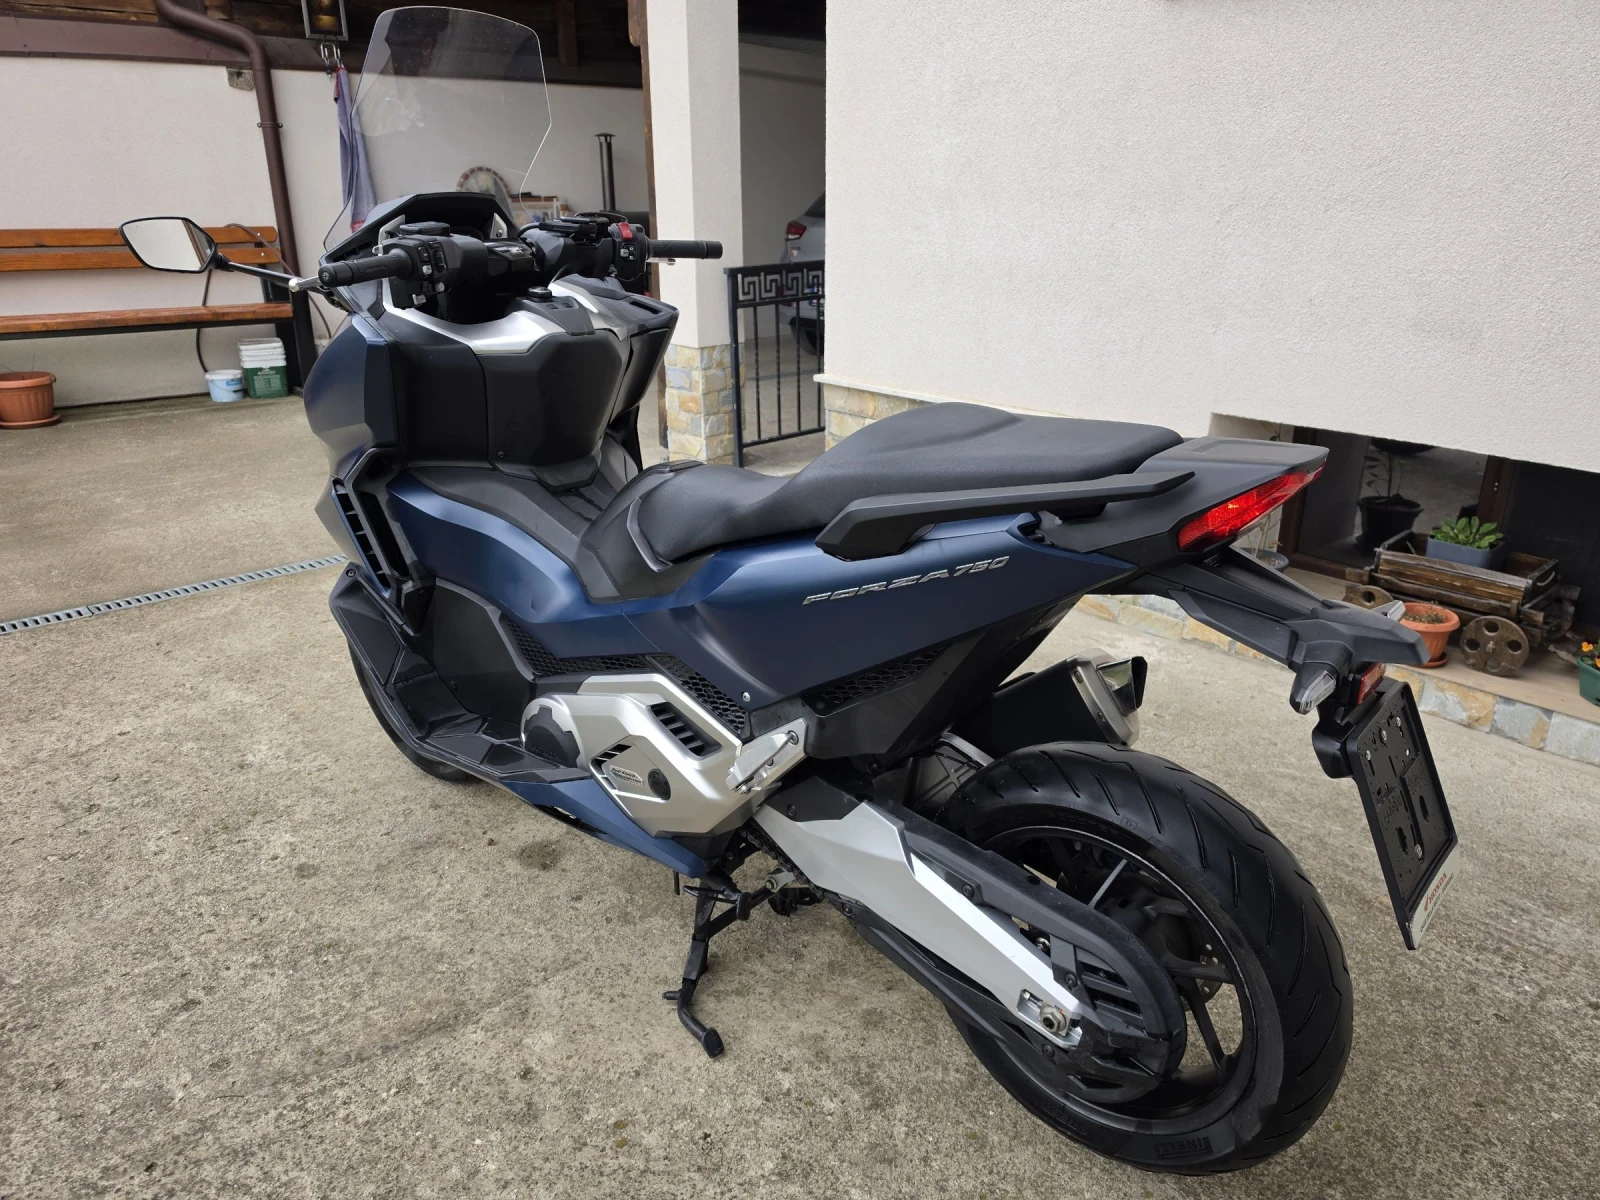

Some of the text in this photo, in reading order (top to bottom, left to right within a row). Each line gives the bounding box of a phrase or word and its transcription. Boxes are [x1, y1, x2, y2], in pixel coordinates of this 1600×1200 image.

[802, 555, 1010, 605] FORZA 750
[1428, 872, 1448, 905] HONDA
[1154, 1136, 1214, 1160] PIRELLI
